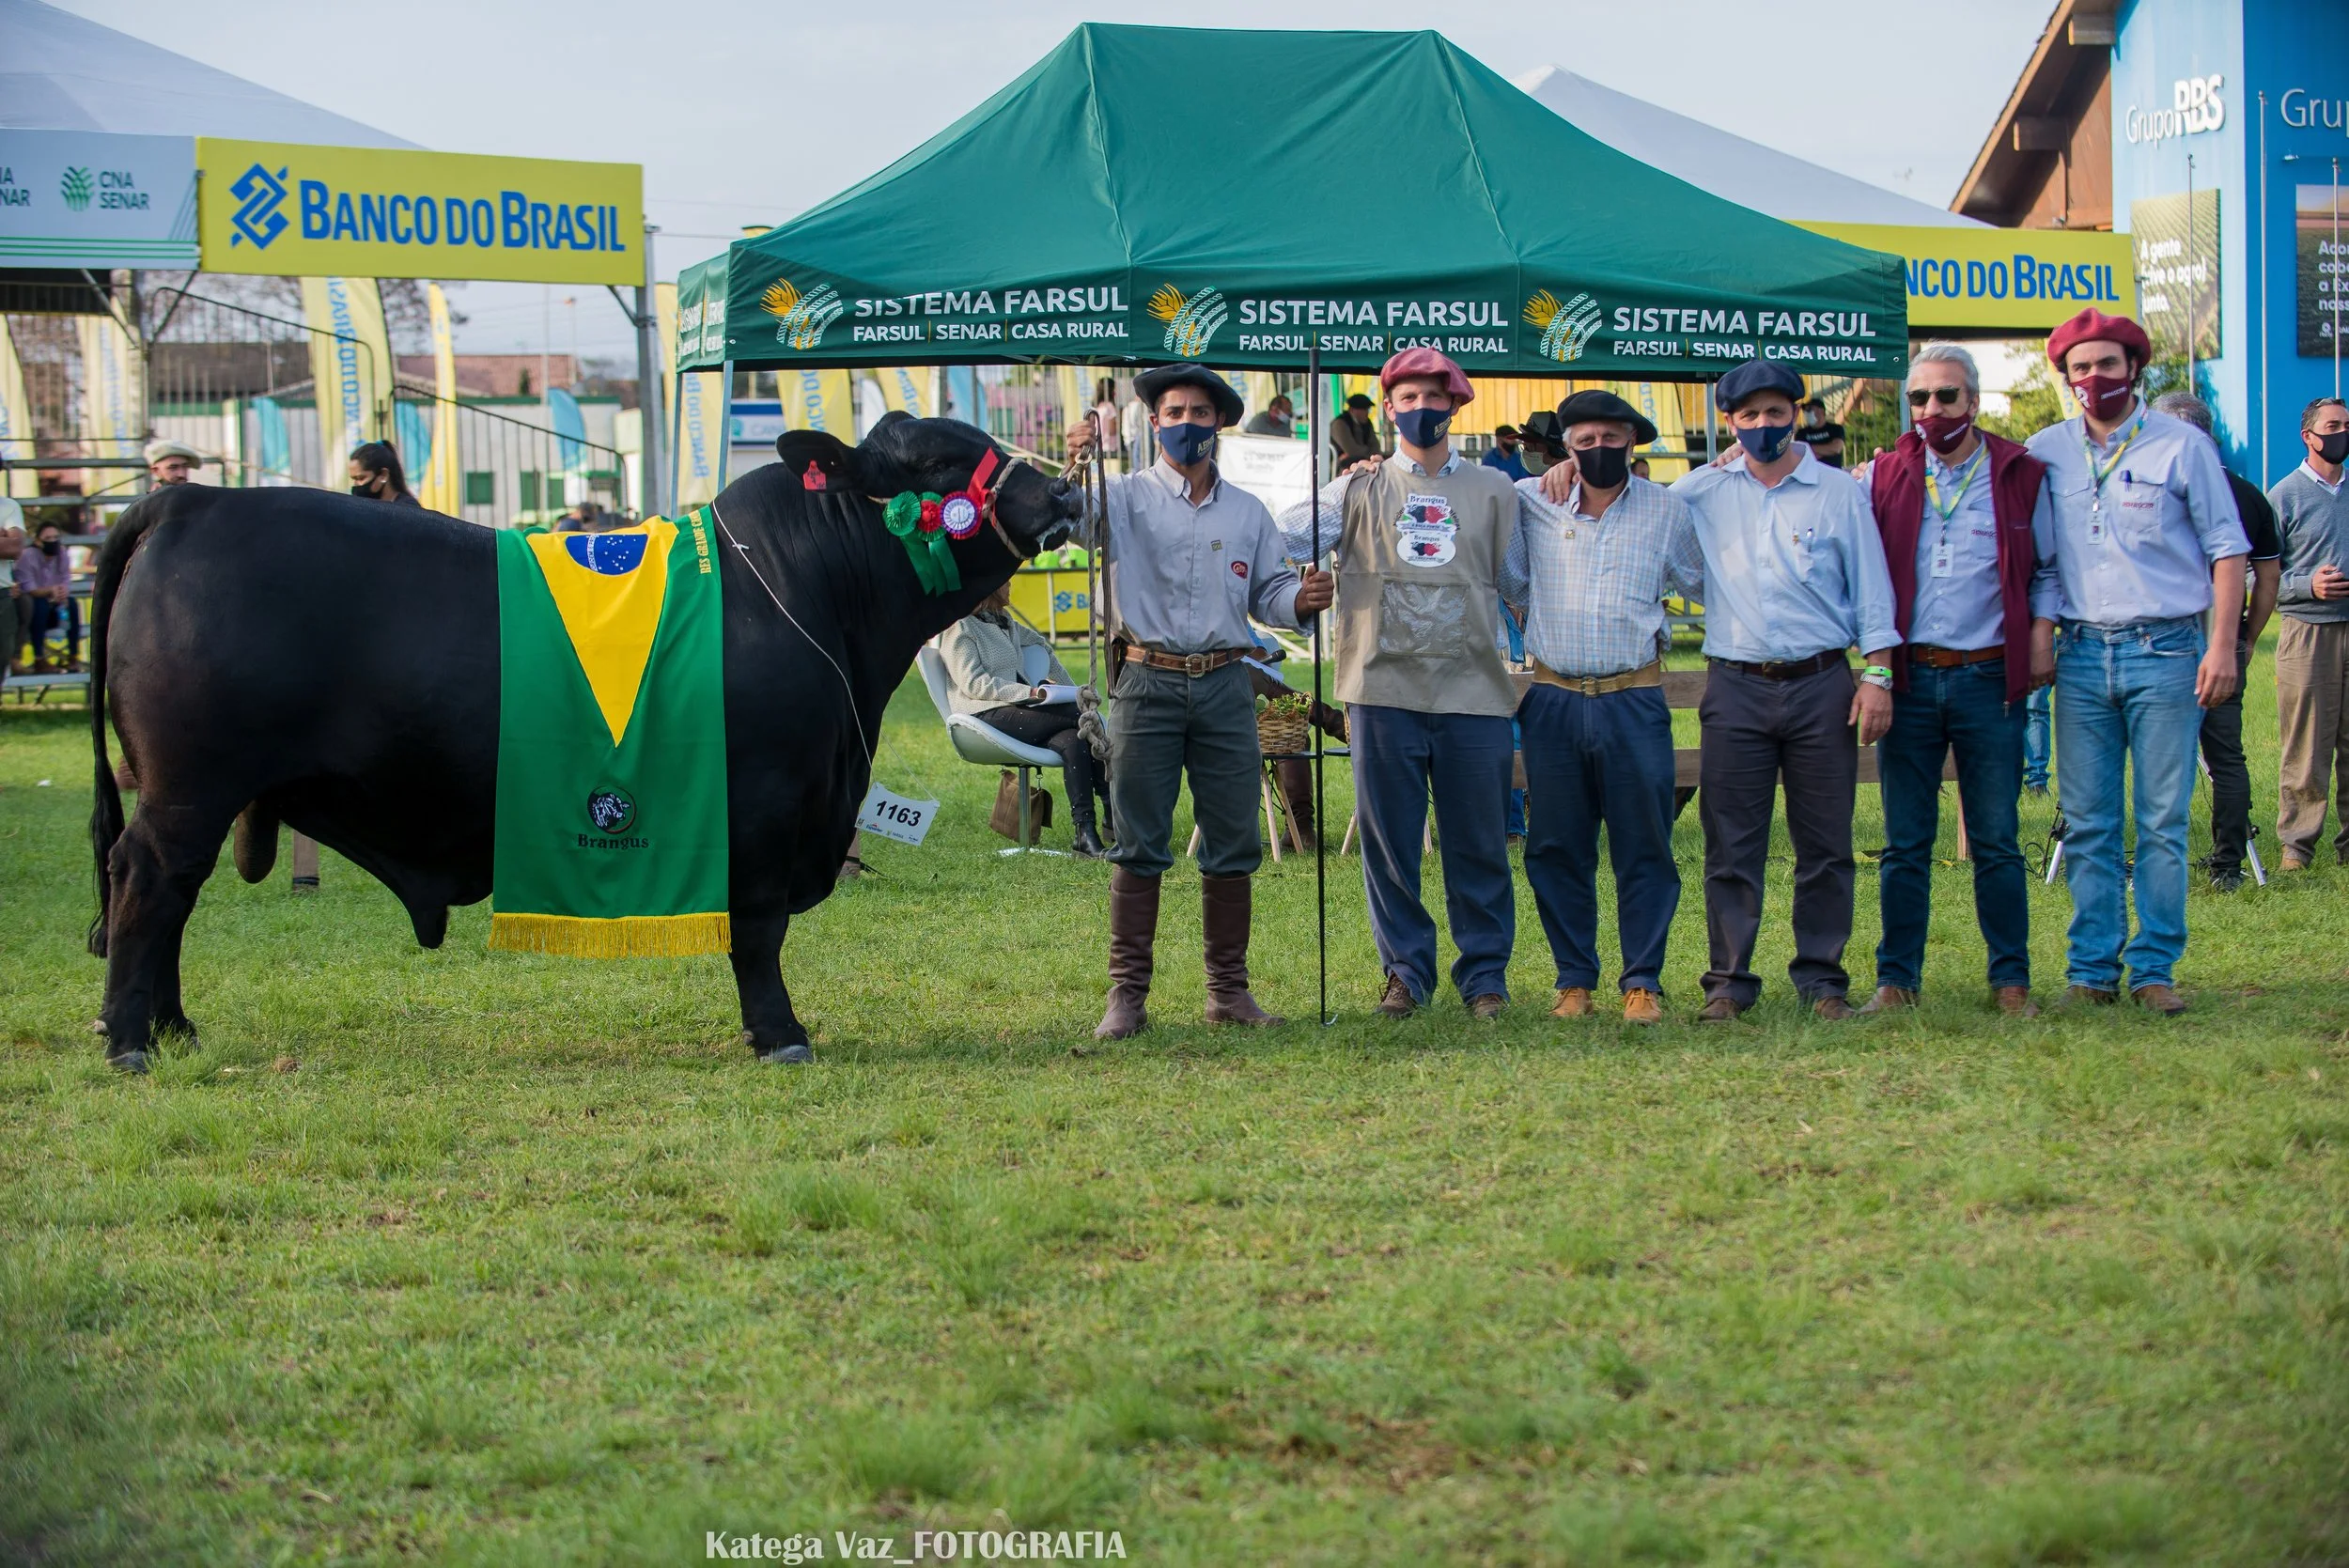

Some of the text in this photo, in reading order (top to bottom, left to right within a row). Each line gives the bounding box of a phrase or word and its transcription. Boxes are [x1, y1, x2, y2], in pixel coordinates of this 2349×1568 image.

[2280, 87, 2349, 139] Gru
[99, 171, 134, 189] CNA
[0, 189, 30, 207] NCO
[99, 193, 150, 210] SENAR
[299, 179, 626, 252] BANCO DO BRASIL
[2140, 238, 2182, 264] A gente
[2318, 240, 2349, 256] Aco
[1906, 255, 2120, 301] NCO DO BRASIL
[854, 287, 1128, 318] SISTEMA FARSUL
[1239, 300, 1509, 327] SISTEMA FARSUL
[853, 322, 1128, 341] FARSUL SENAR CASA RURAL
[1613, 307, 1876, 337] SISTEMA FARSUL
[1239, 334, 1509, 352] FARSUL SENAR CASA RURAL
[1613, 340, 1876, 362] FARSUL SENAR CASA RURAL
[876, 800, 922, 827] 1163
[578, 833, 649, 850] Brangus
